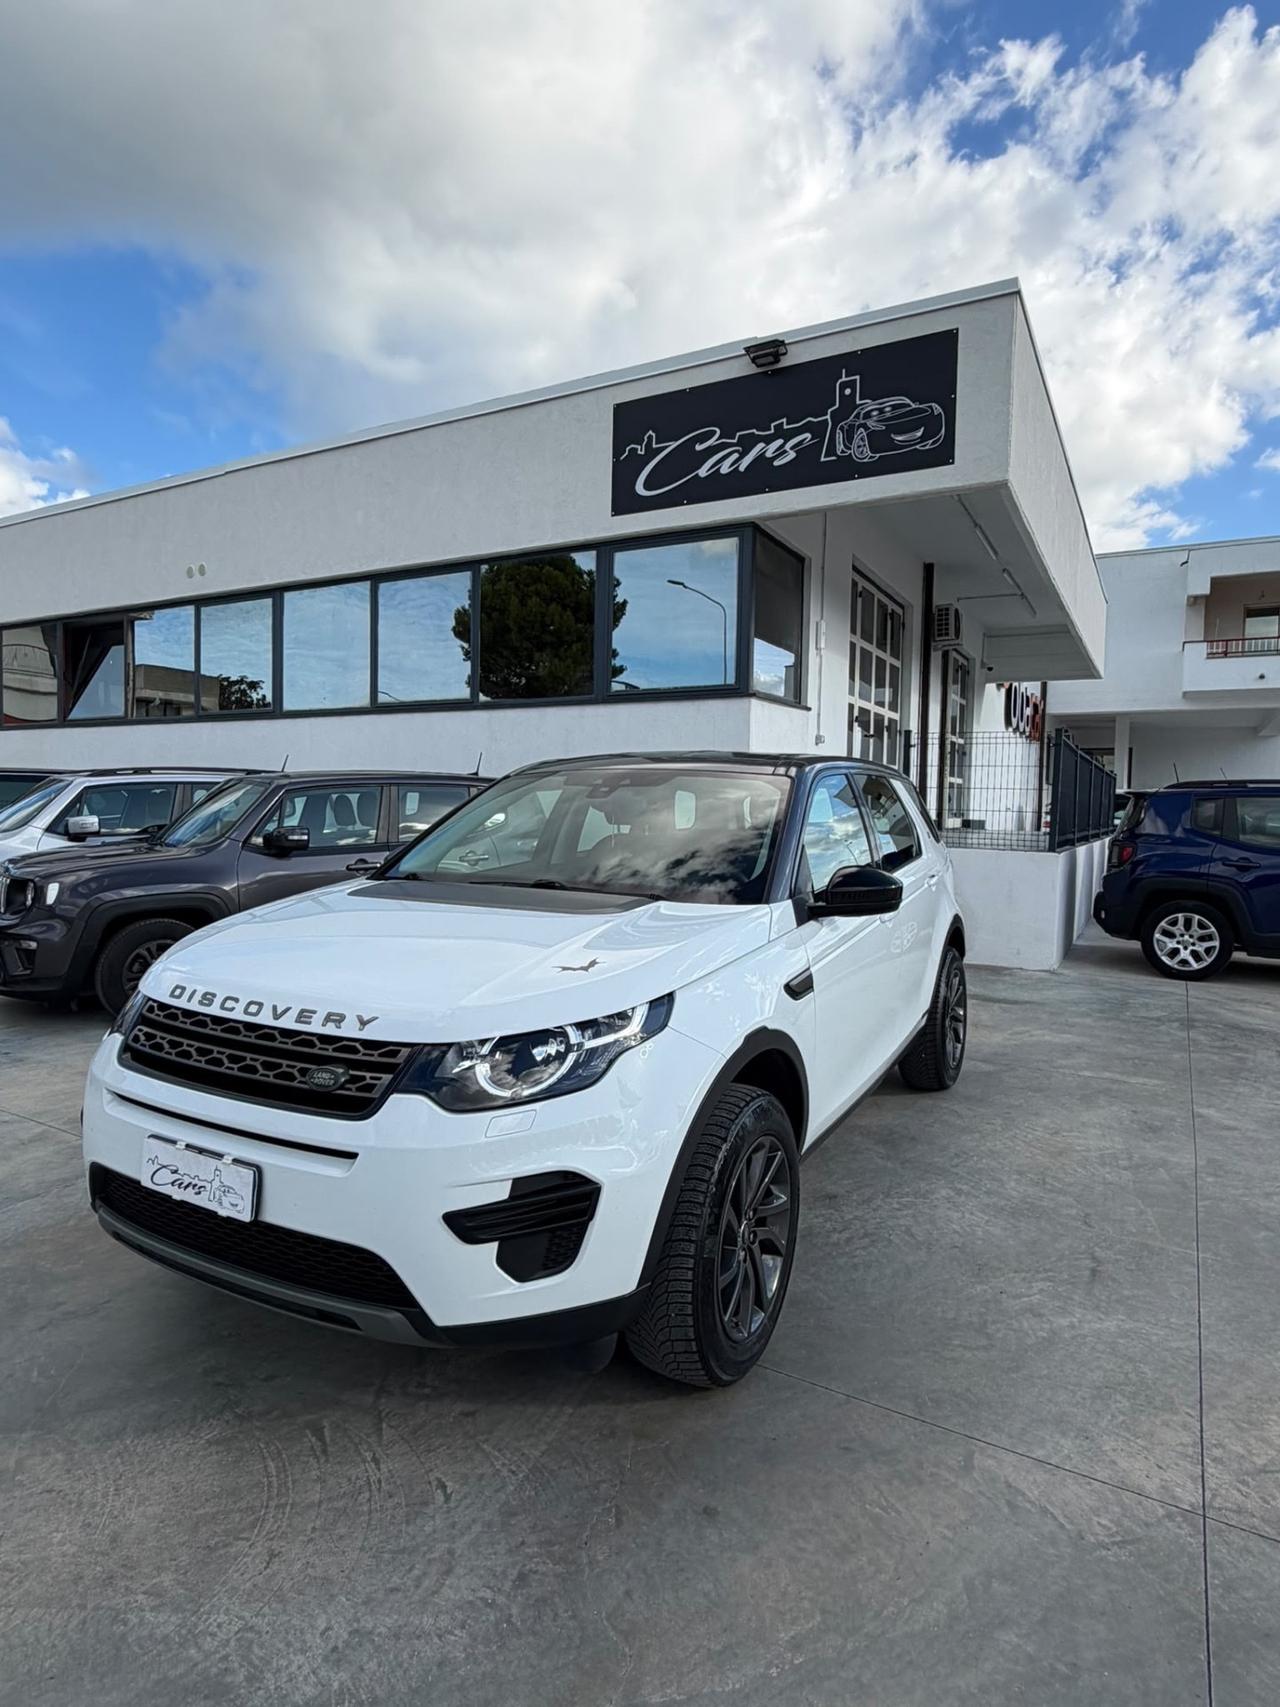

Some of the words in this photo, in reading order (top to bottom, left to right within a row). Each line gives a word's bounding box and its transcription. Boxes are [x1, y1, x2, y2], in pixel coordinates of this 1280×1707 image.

[635, 427, 820, 497] Cars
[169, 984, 379, 1031] DISCOVERY
[150, 1163, 208, 1195] Cars
